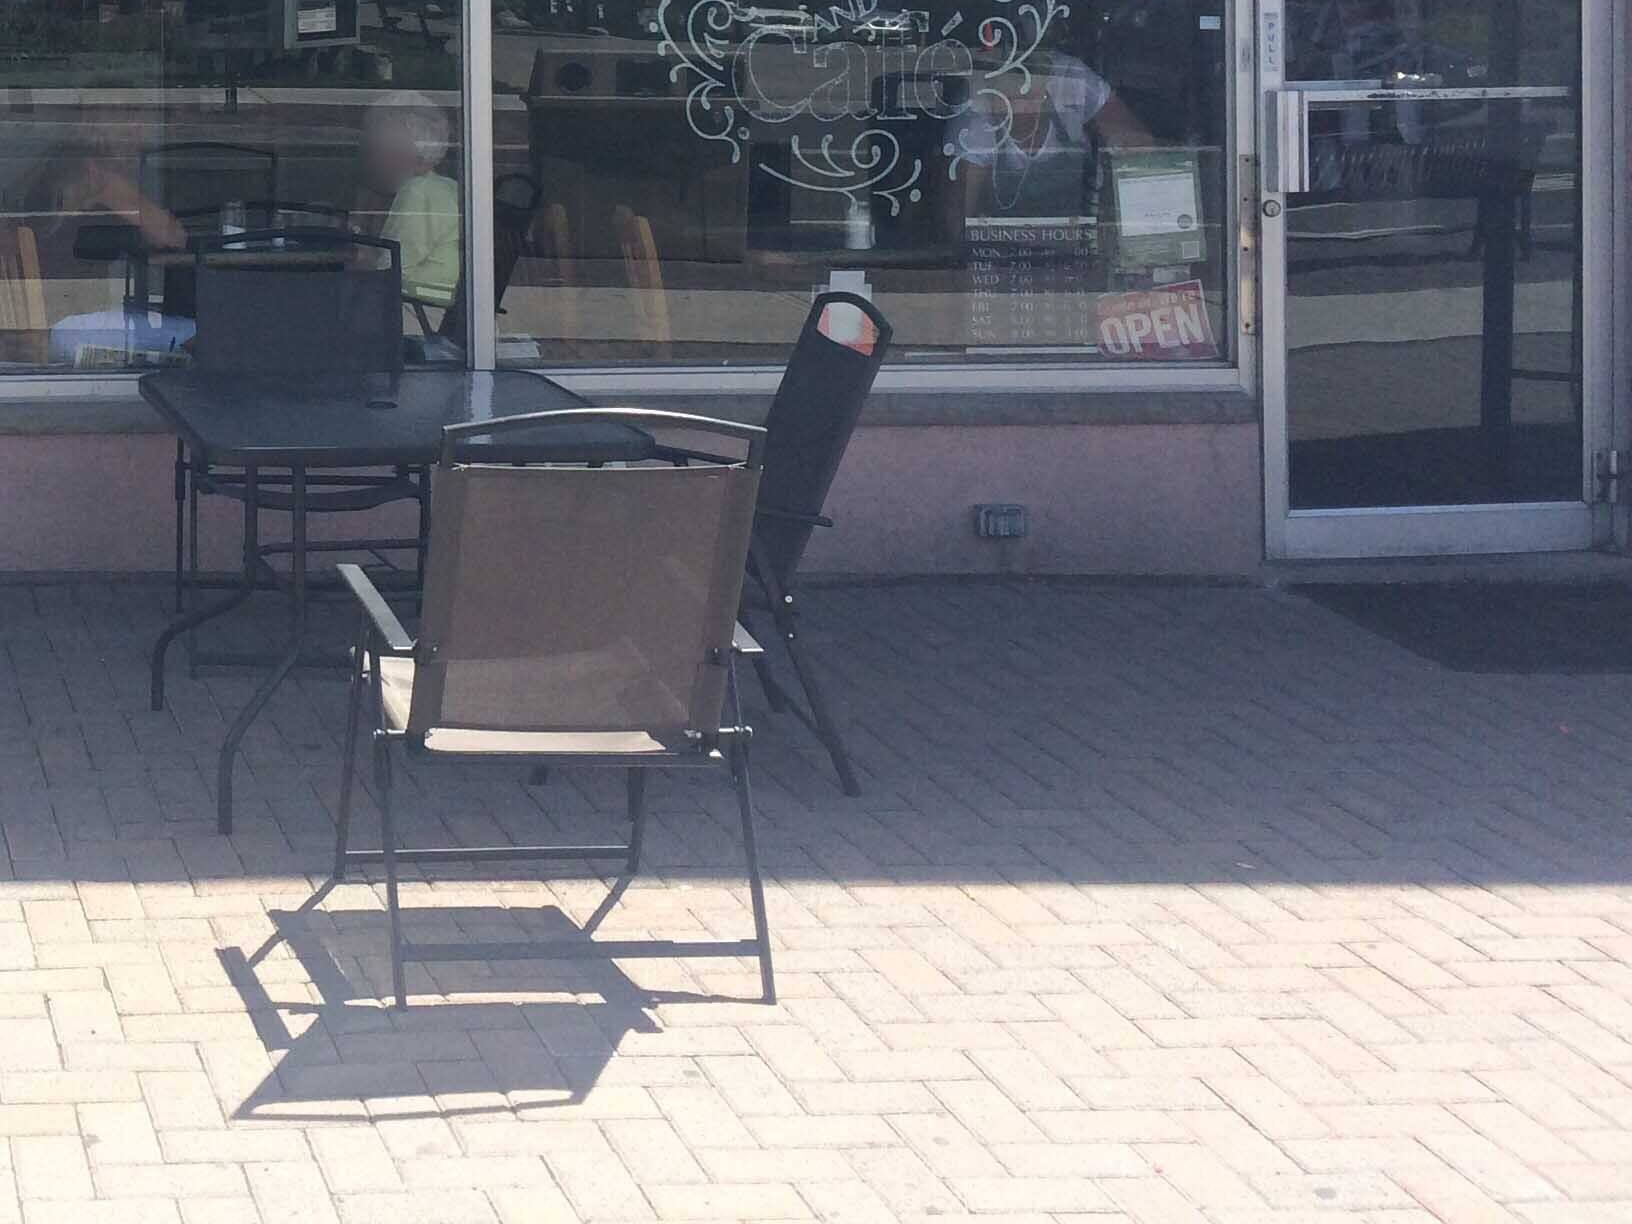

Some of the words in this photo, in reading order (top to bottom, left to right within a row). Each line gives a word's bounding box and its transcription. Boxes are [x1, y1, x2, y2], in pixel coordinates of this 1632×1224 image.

[731, 9, 974, 124] Café
[969, 229, 1036, 241] BUSINESS
[1041, 228, 1092, 241] HOURS
[1100, 303, 1205, 355] OPEN
